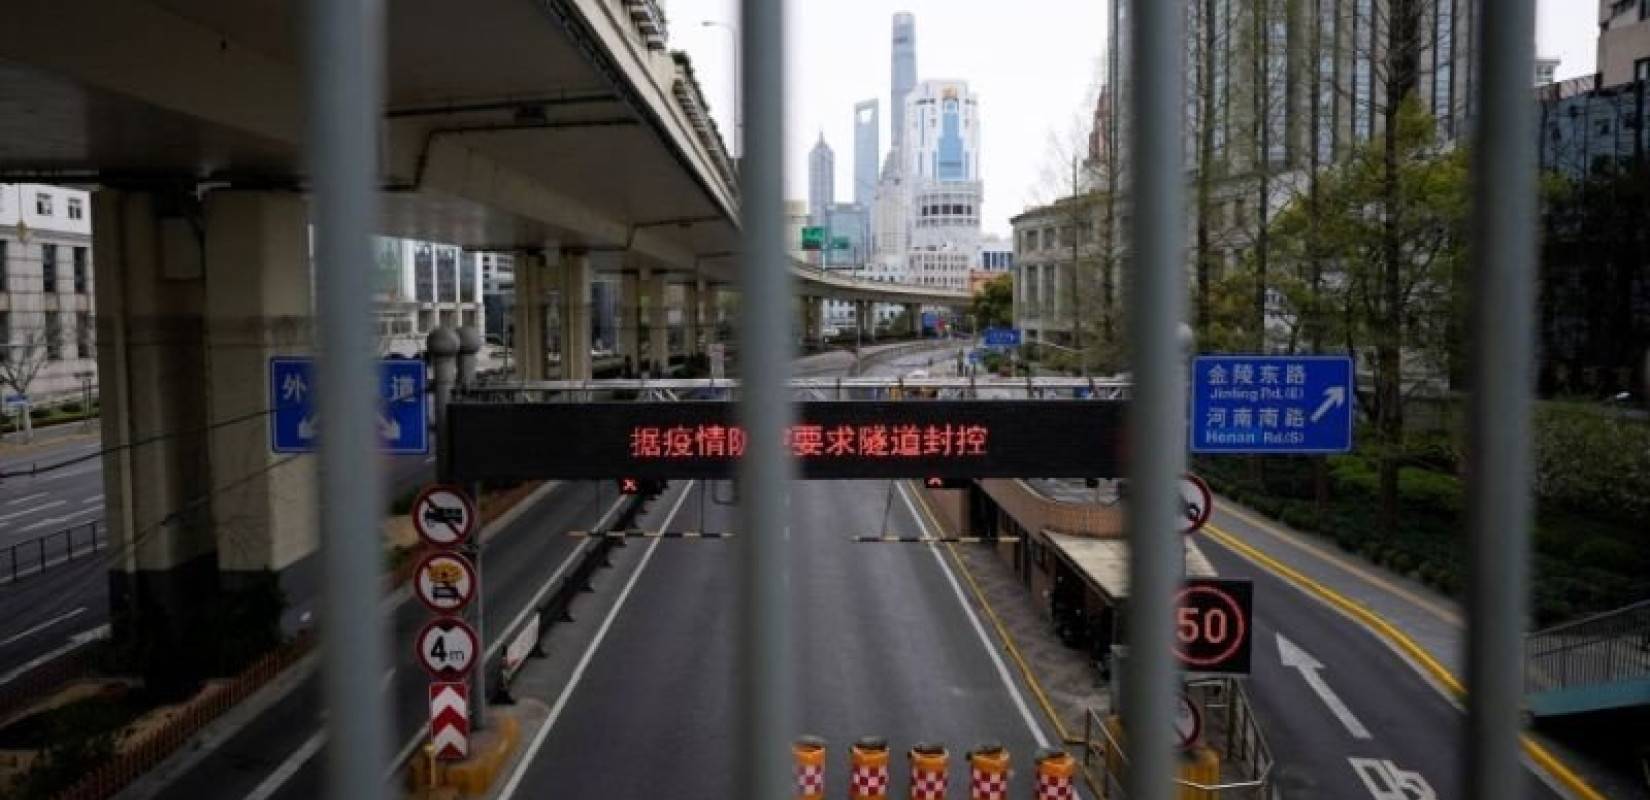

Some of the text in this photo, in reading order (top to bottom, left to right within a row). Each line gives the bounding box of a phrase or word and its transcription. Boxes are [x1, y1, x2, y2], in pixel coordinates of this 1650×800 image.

[1207, 363, 1305, 384] 金陵东路
[1210, 387, 1258, 402] Jinling
[1206, 408, 1305, 428] 河南南路
[629, 424, 988, 456] 据疫情防要求隧道封控
[1206, 431, 1255, 443] Henan
[1176, 608, 1227, 644] 50
